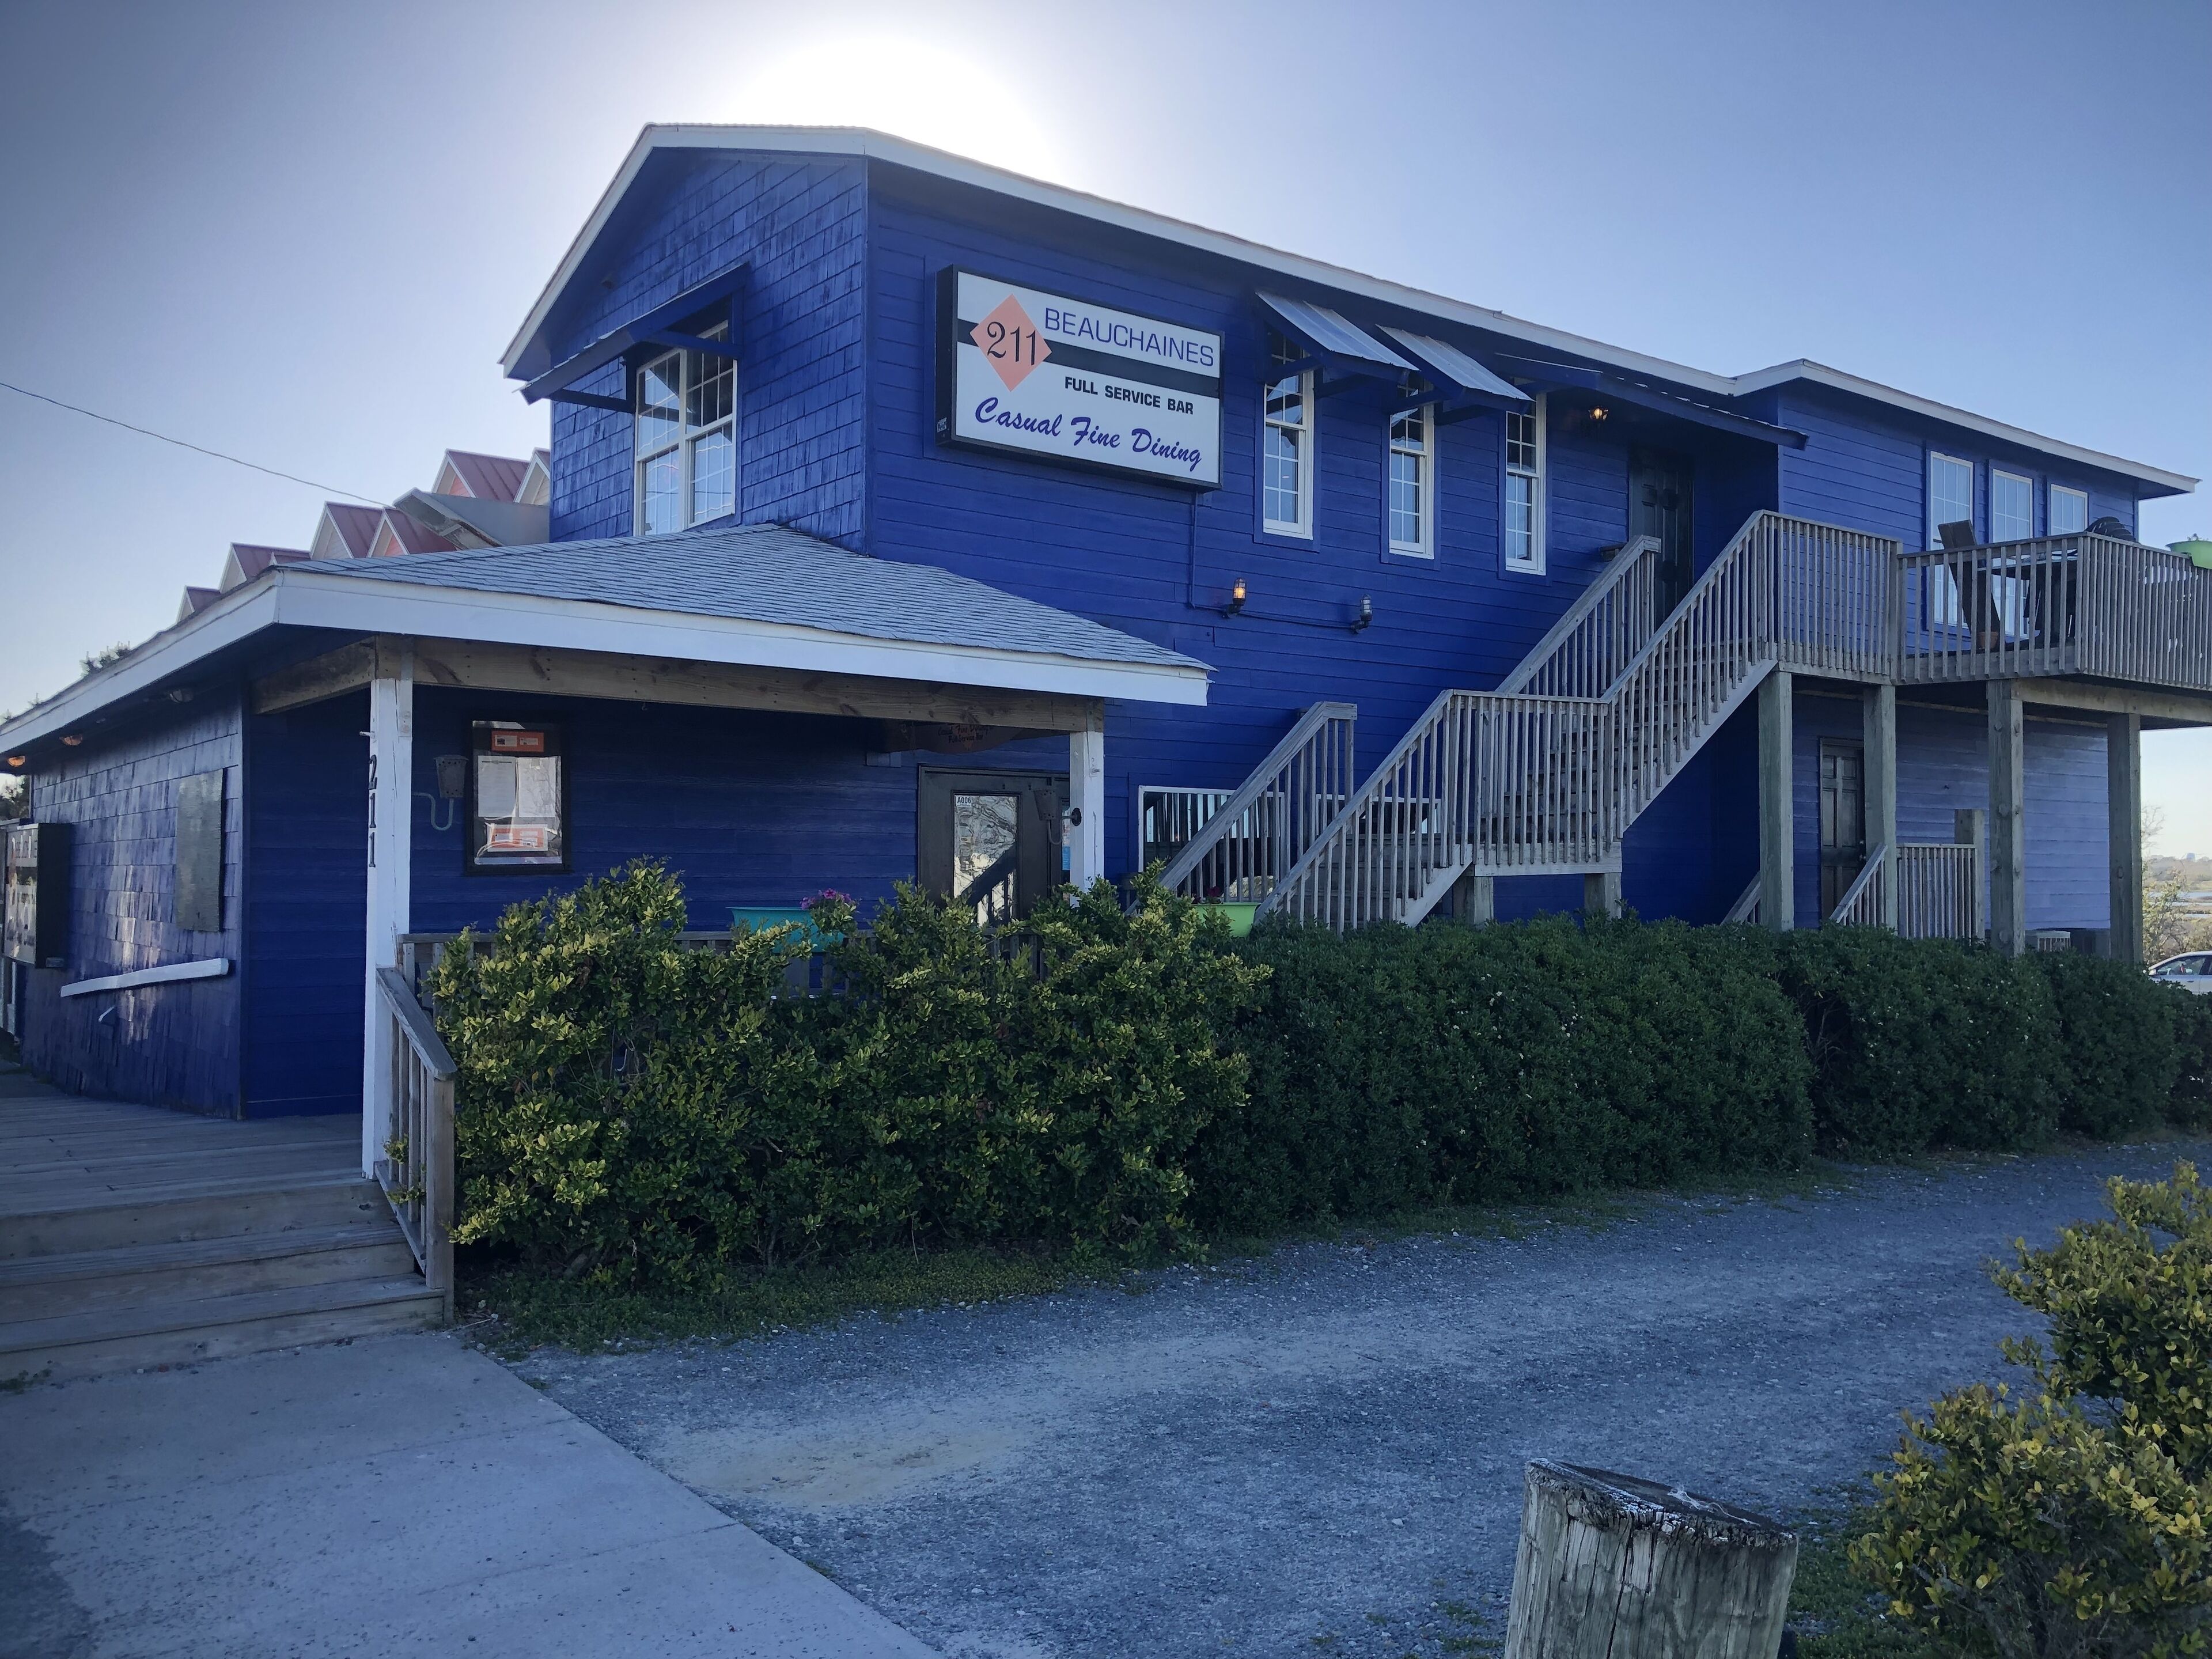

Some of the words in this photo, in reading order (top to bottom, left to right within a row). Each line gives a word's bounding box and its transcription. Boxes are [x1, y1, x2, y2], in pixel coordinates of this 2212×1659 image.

[986, 321, 1037, 366] 211
[1044, 307, 1214, 367] BEAUCHAINES
[1065, 376, 1098, 395] FULL
[1105, 384, 1161, 408] SERVICE
[1168, 398, 1194, 415] BAR
[975, 396, 1062, 437] Casual
[1070, 416, 1120, 449] Fine
[1131, 427, 1202, 472] Dining
